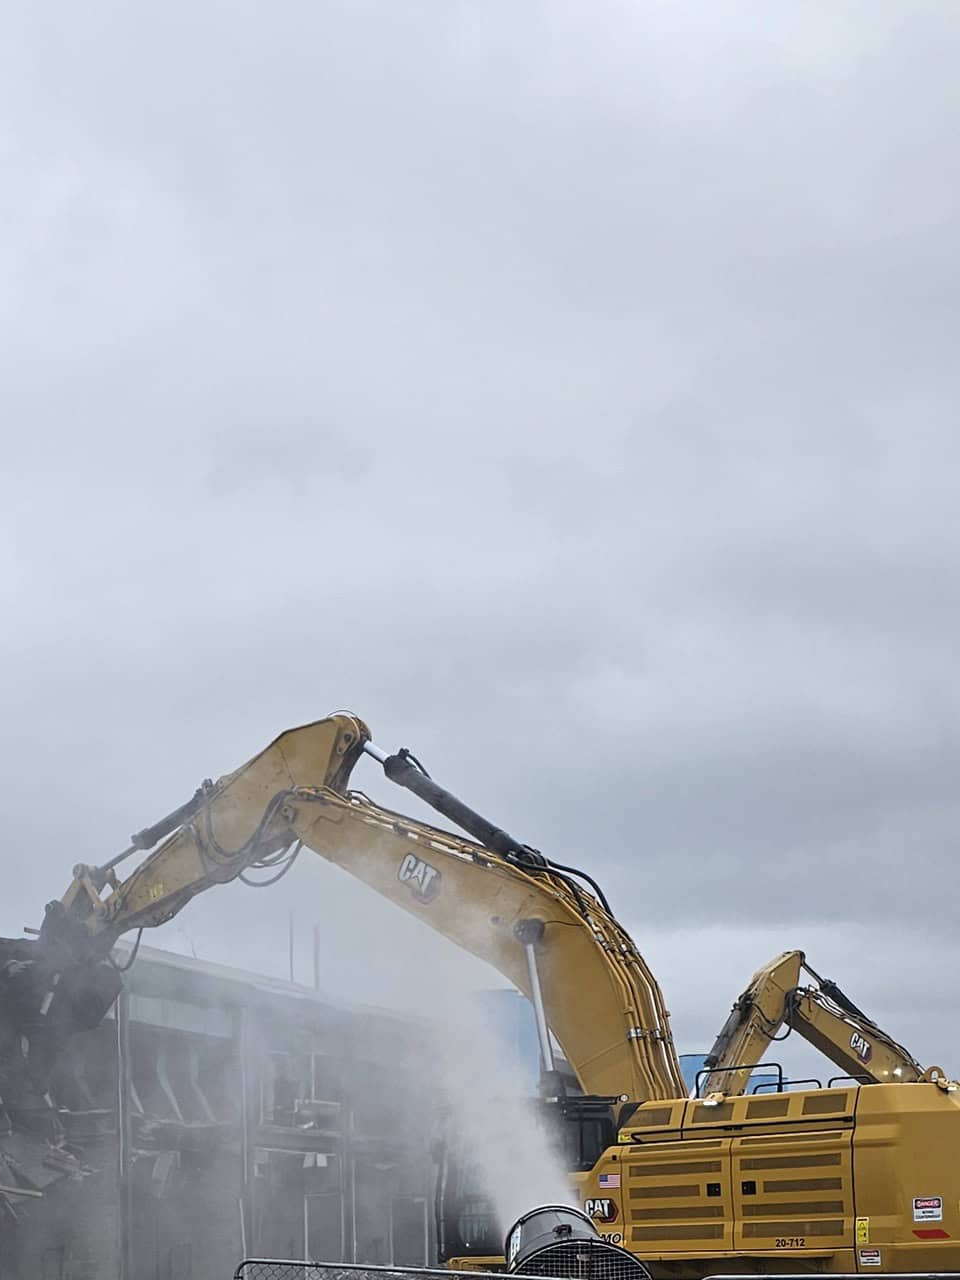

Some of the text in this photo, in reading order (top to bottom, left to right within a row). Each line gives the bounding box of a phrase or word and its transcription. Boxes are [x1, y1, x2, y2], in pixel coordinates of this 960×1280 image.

[399, 853, 437, 895] CAT
[850, 1032, 870, 1058] CAT
[585, 1199, 610, 1218] CAT
[775, 1238, 806, 1248] 20-712
